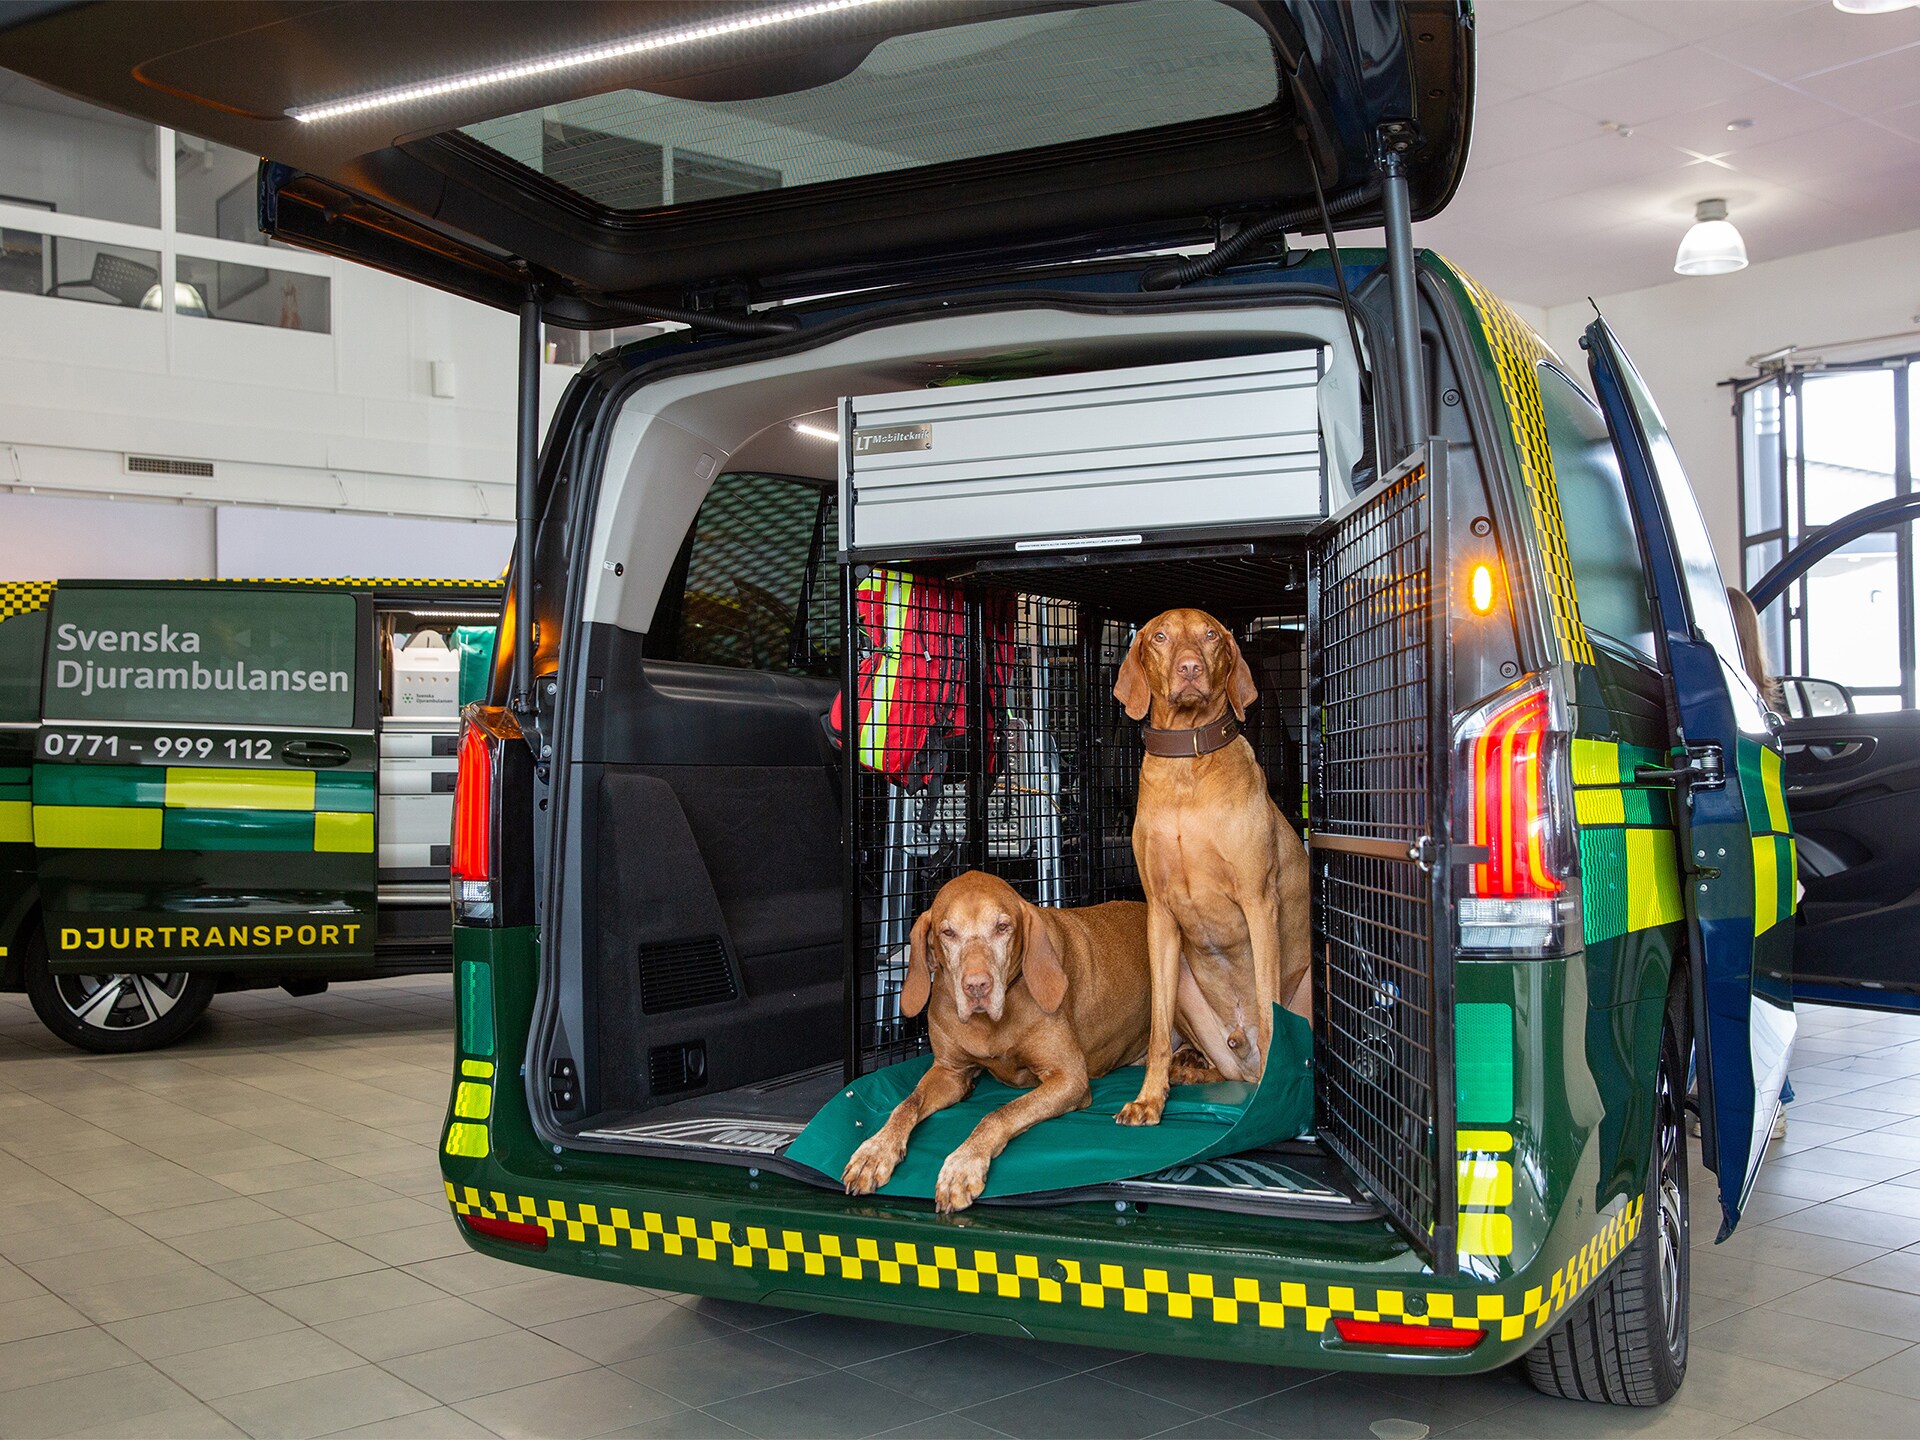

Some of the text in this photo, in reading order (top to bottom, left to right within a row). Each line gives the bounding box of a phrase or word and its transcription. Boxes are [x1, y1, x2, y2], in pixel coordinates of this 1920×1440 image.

[872, 430, 930, 444] Mobilteknik
[56, 623, 201, 653] Svenska
[56, 660, 350, 696] Djurambulansen
[44, 733, 119, 758] 0771
[155, 736, 214, 759] 999
[223, 739, 273, 760] 112
[60, 923, 362, 951] DJURTRANSPORT
